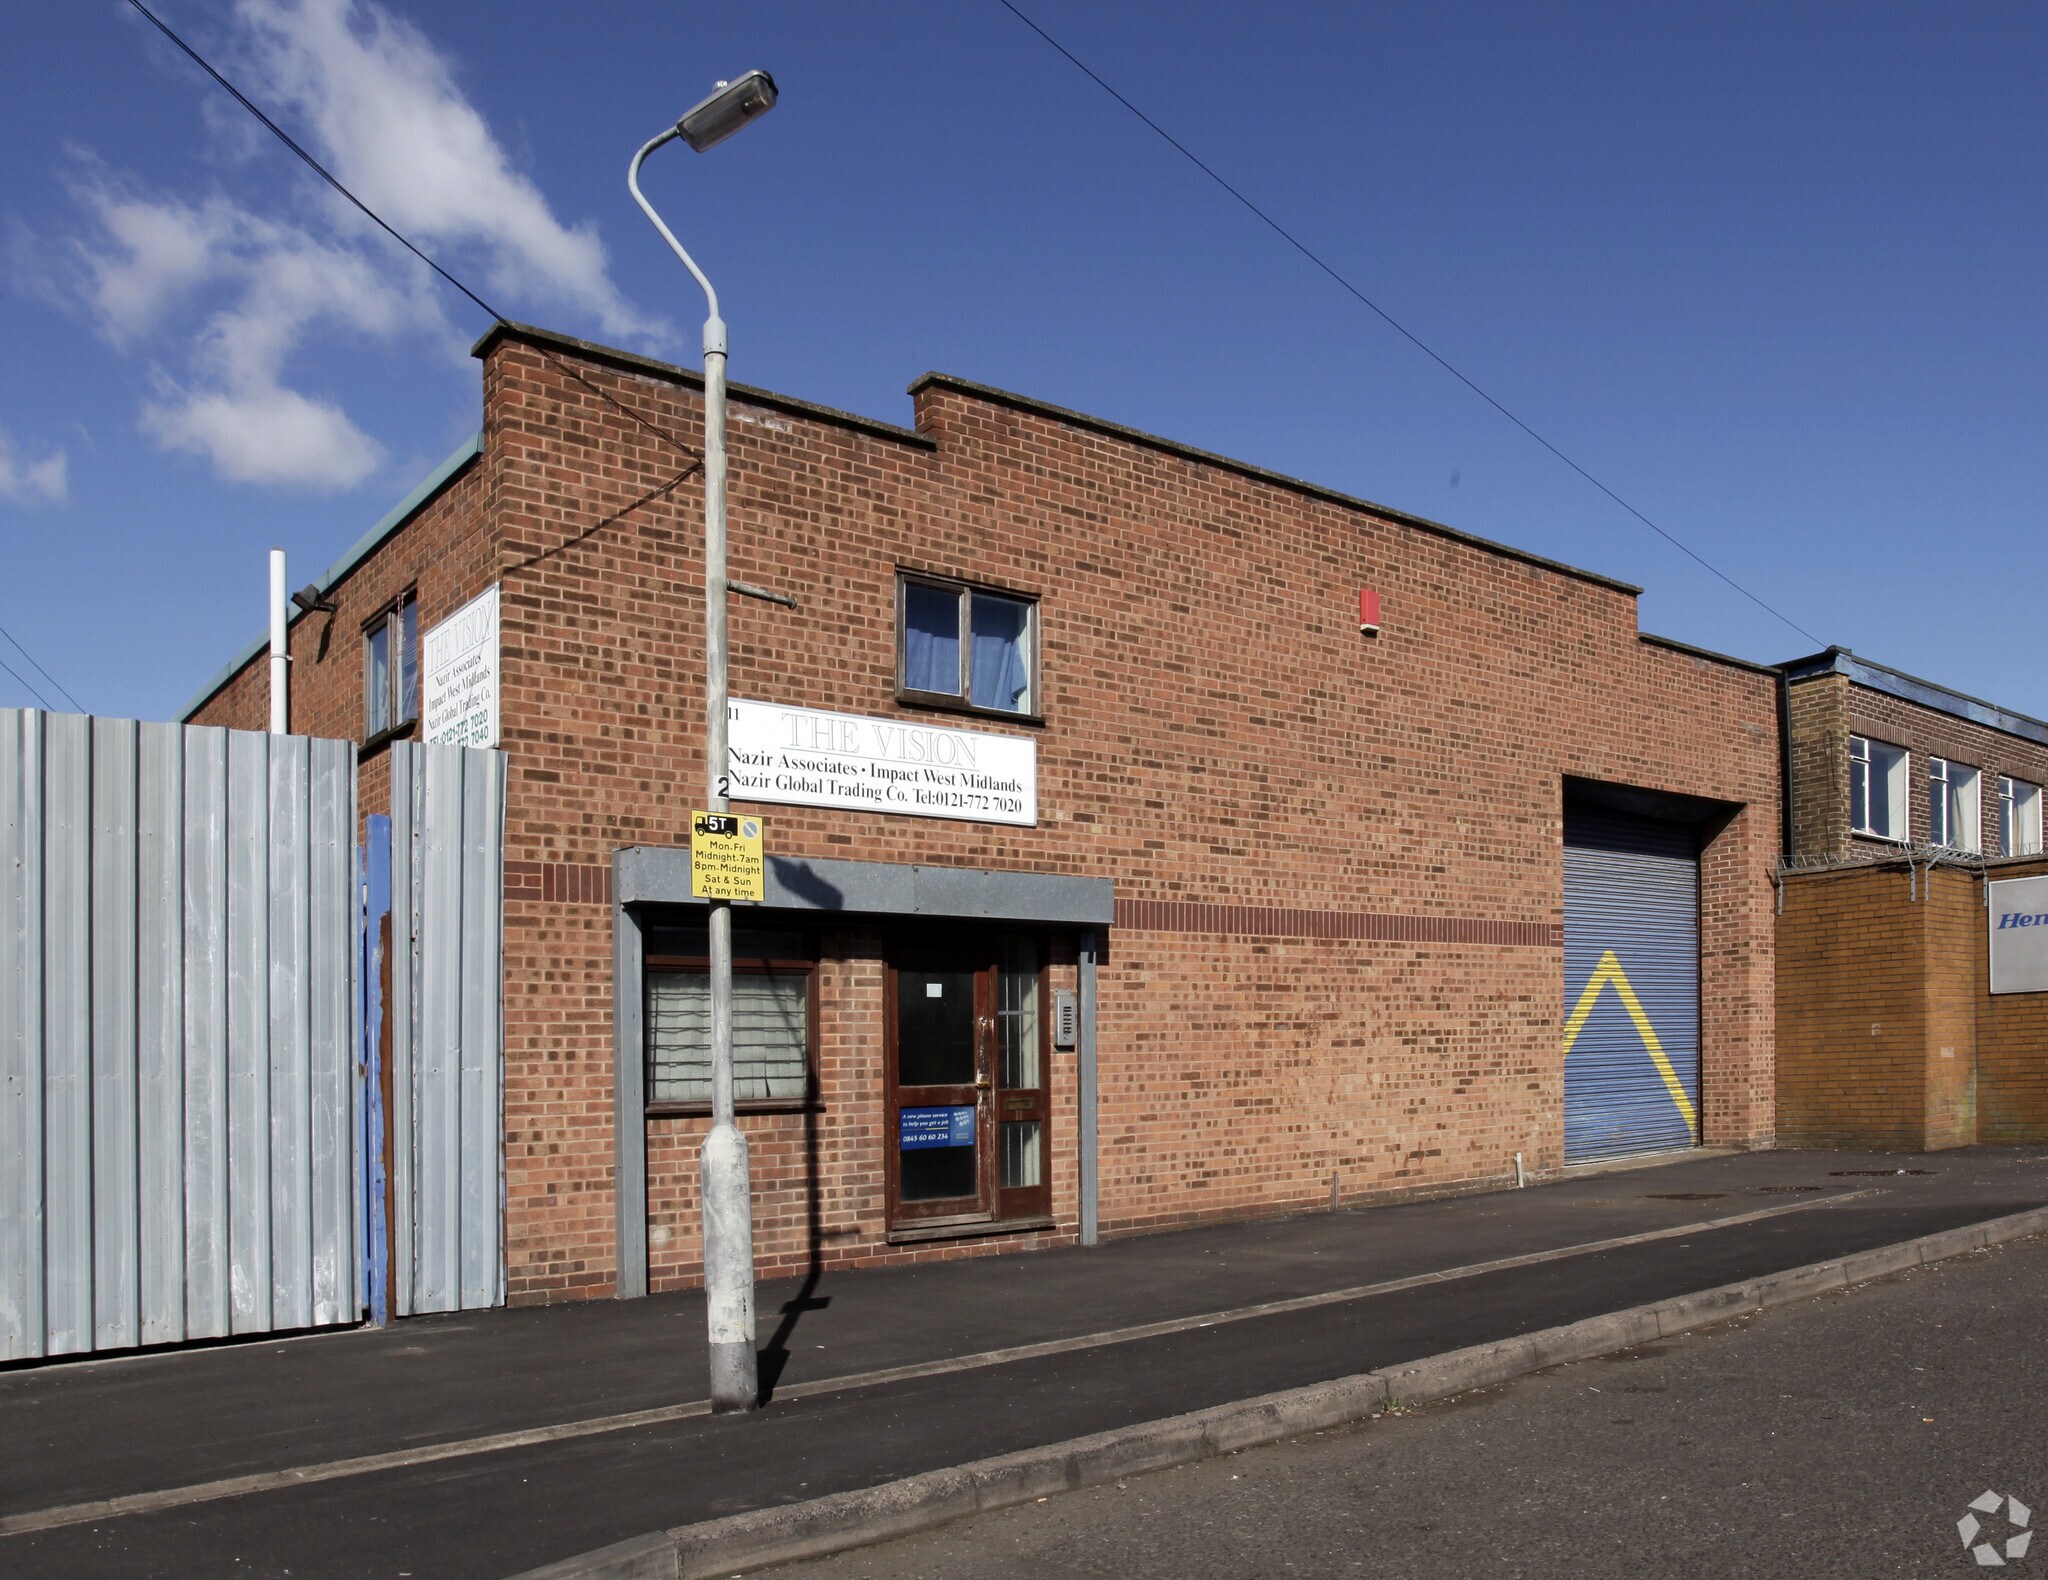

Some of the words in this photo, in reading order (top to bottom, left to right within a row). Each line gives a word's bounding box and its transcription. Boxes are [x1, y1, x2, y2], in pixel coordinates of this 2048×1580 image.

[428, 628, 451, 673] THE
[454, 600, 491, 655] VISION
[436, 669, 450, 686] Nazir
[453, 652, 481, 678] Associates
[428, 692, 447, 712] Impact
[447, 684, 461, 699] West
[462, 665, 491, 690] Midlands
[428, 714, 441, 730] Nazir
[441, 702, 458, 723] Global
[459, 693, 480, 714] Trading
[471, 709, 488, 729] 7020
[471, 725, 489, 746] 7040
[781, 712, 860, 754] THE
[871, 724, 978, 768] VISION
[728, 747, 773, 767] Nazir
[778, 753, 858, 776] Associates
[870, 763, 920, 784] Impact
[923, 768, 957, 787] West
[960, 773, 1023, 793] Midlands
[729, 769, 771, 789] Nazir
[775, 774, 823, 794] Global
[827, 779, 882, 803] Trading
[886, 785, 908, 802] Co.
[912, 788, 989, 811] Tel:0121-772
[994, 797, 1022, 813] 7020
[708, 816, 727, 831] 5T
[702, 885, 712, 894] At
[715, 886, 731, 896] any
[734, 887, 755, 897] time
[704, 874, 721, 884] Sat
[723, 875, 730, 884] &
[733, 876, 752, 886] Sun
